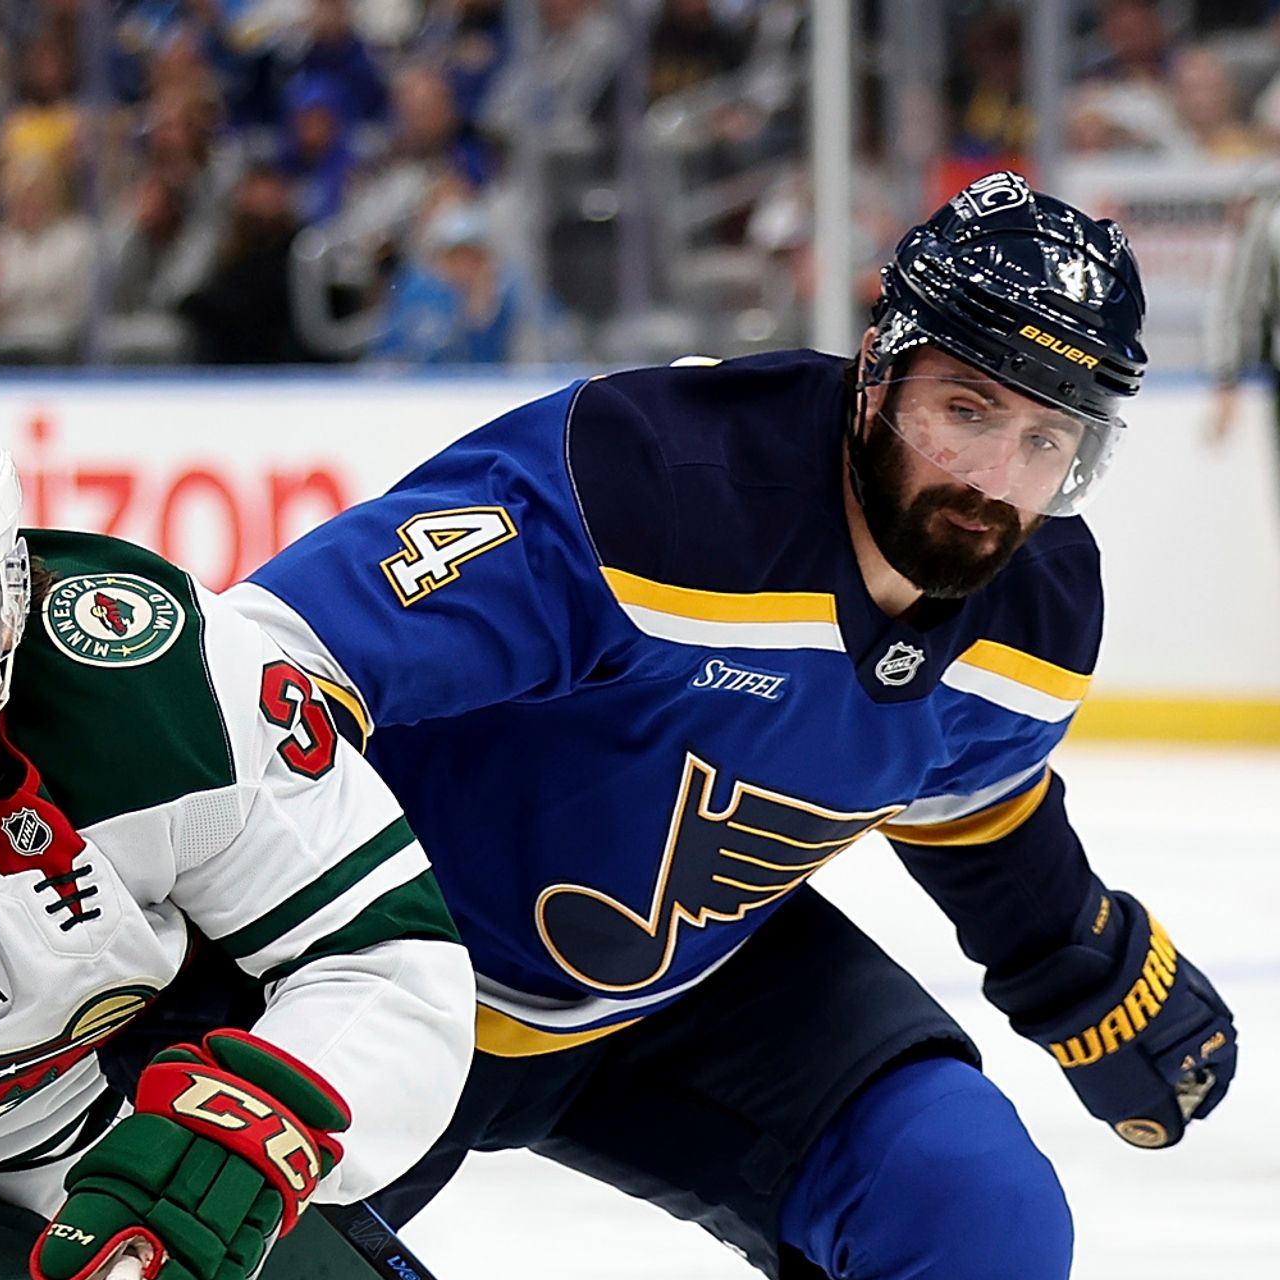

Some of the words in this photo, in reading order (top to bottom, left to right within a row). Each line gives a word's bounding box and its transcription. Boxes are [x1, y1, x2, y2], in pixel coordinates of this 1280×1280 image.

[379, 505, 519, 608] 4
[53, 578, 111, 659] MINNESOTA
[148, 593, 175, 631] WILD
[692, 659, 786, 700] STIFEL
[172, 1073, 320, 1216] CC
